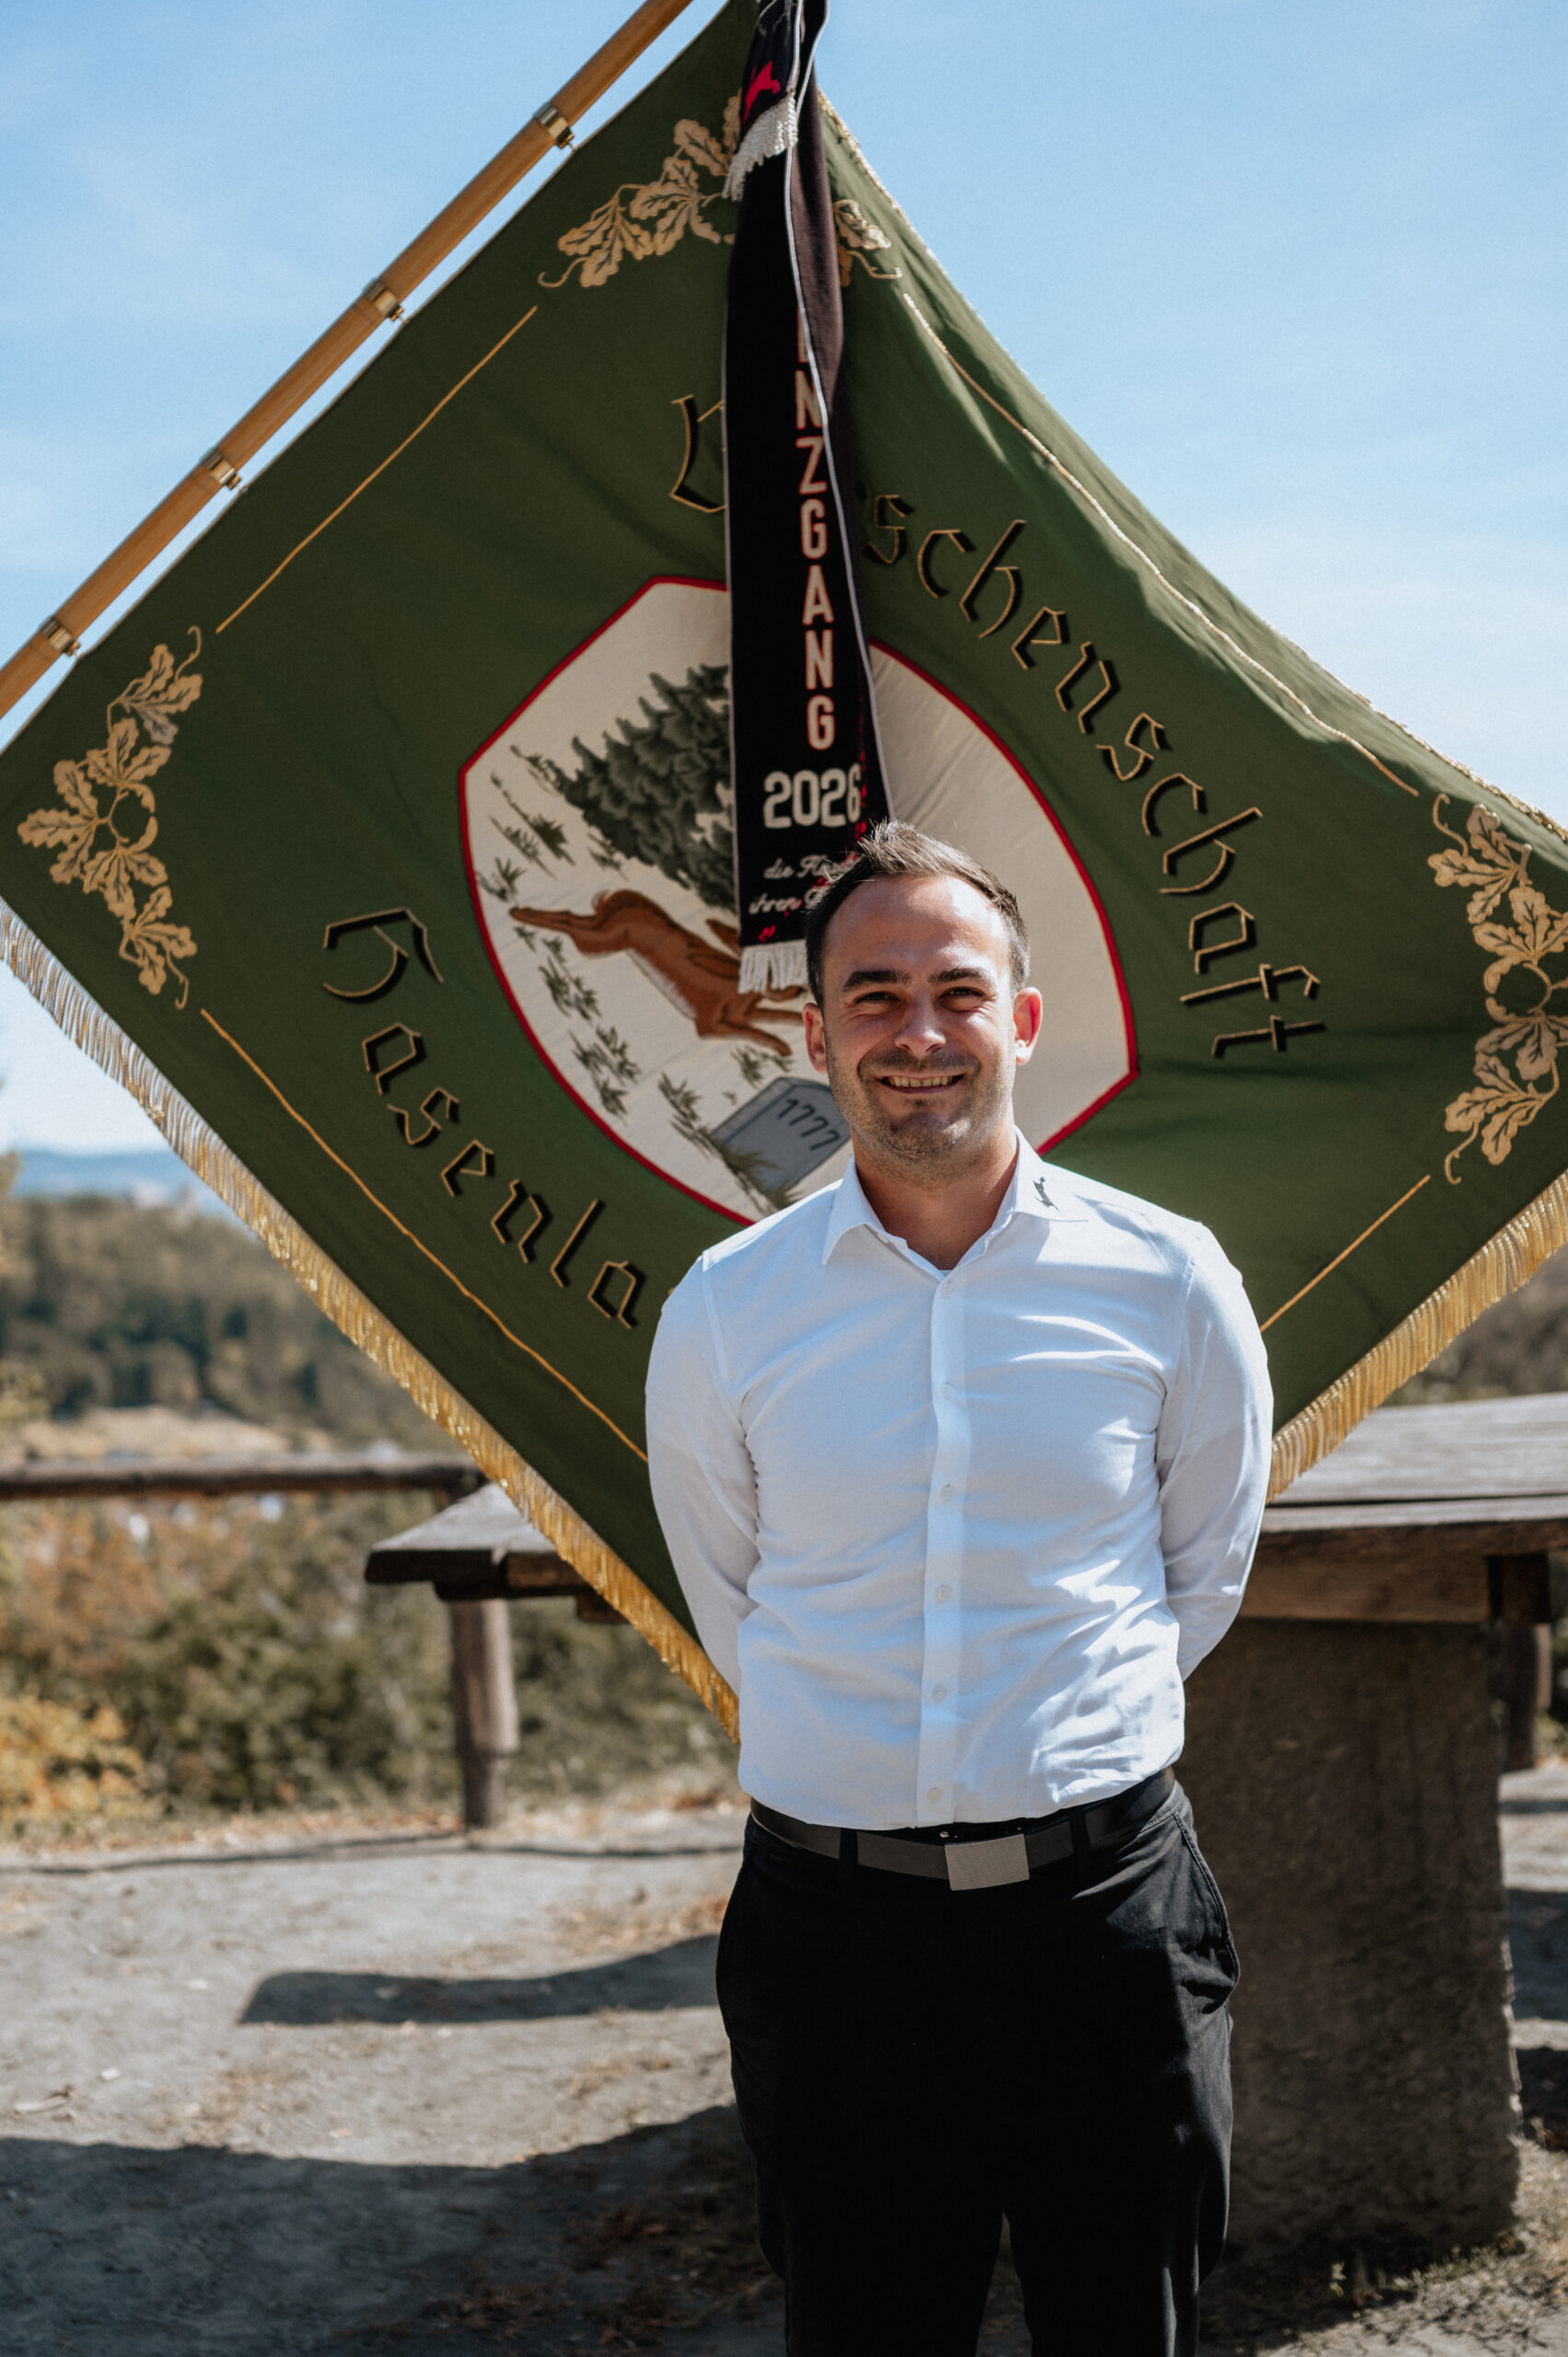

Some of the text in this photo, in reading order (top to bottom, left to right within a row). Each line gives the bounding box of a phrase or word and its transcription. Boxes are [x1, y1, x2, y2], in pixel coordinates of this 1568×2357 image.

[669, 393, 1327, 1059] schenschaft
[795, 305, 836, 751] NZGANG
[761, 763, 862, 829] 2026
